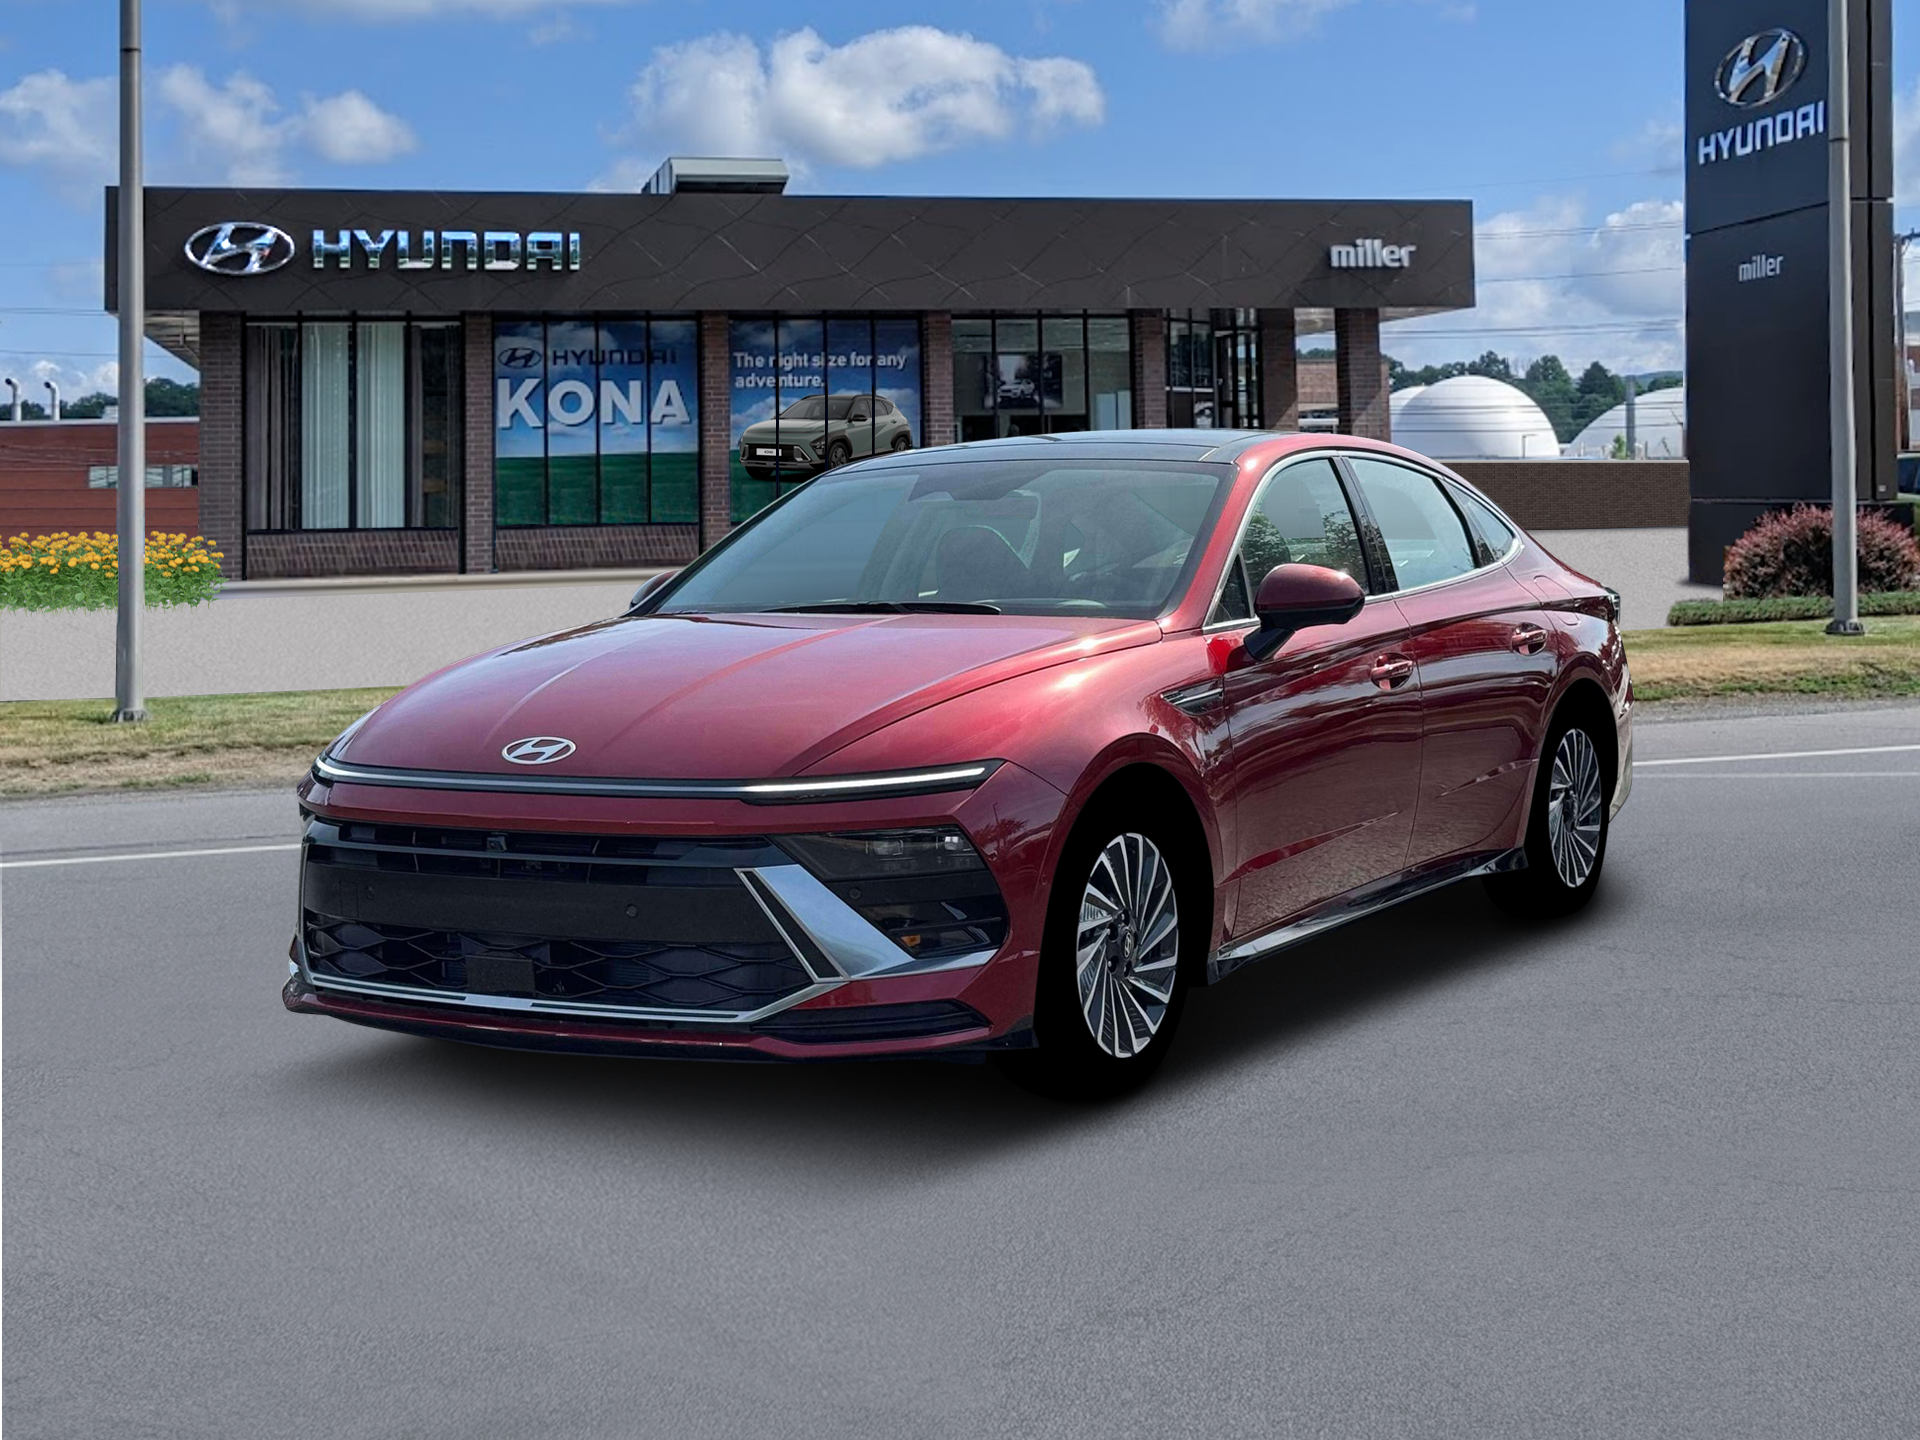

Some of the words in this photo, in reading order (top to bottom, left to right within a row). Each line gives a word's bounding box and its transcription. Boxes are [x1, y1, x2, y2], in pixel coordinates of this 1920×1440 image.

[1698, 100, 1826, 165] HYUNDAI
[312, 229, 581, 271] HYUNDAI
[1330, 238, 1417, 268] miller
[1738, 254, 1784, 282] miller
[552, 350, 678, 366] HYUNDAI
[733, 352, 766, 368] The
[769, 352, 808, 371] right
[850, 351, 873, 367] for
[876, 354, 907, 370] any
[734, 372, 825, 389] adventure.
[497, 378, 692, 428] KONA
